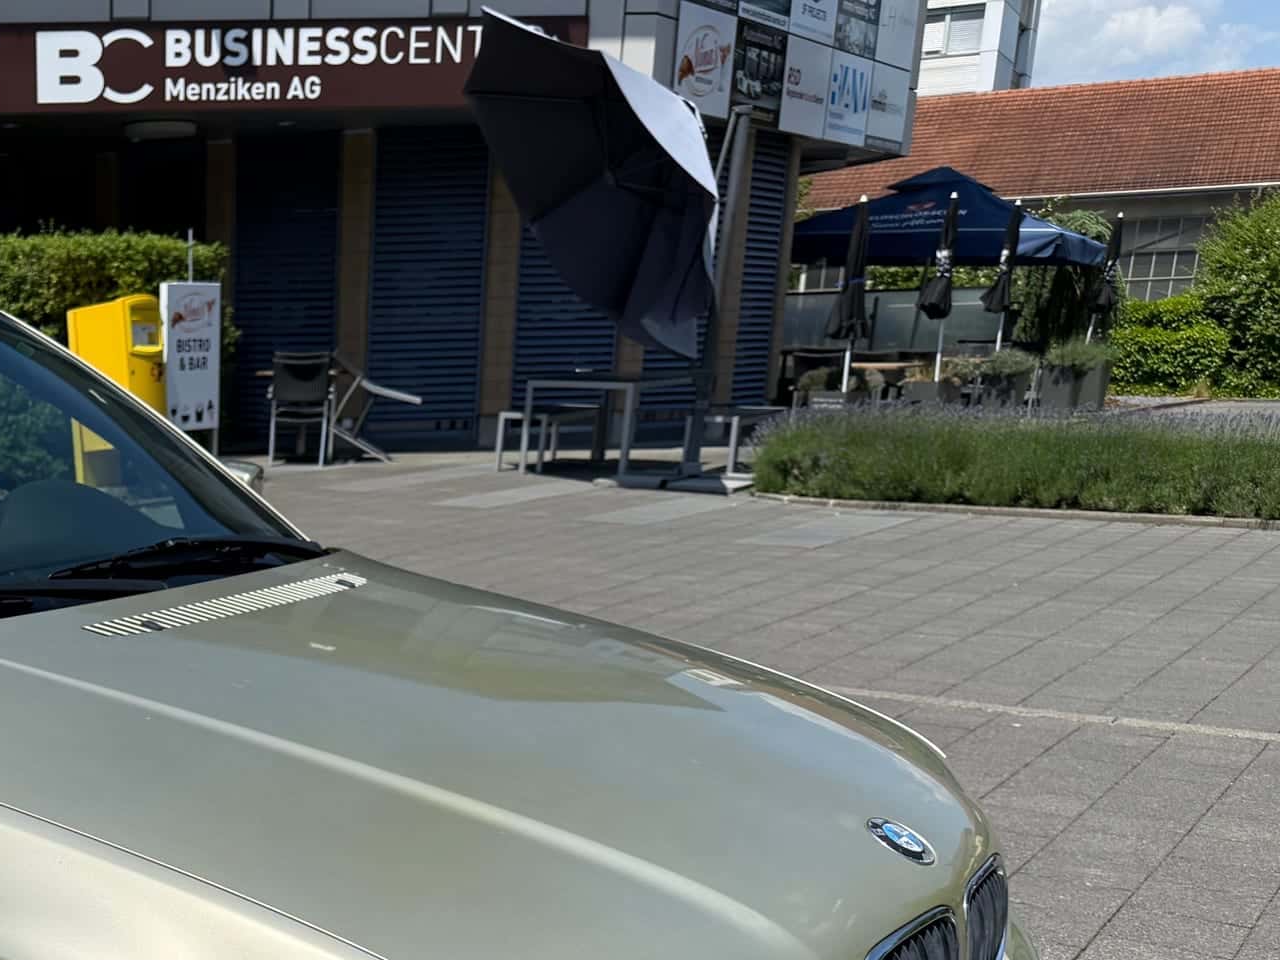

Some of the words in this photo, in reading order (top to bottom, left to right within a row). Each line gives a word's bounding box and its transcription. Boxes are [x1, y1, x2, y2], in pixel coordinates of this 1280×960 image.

[165, 25, 545, 67] BUSINESSCENT
[35, 28, 154, 104] BC
[165, 76, 280, 102] Menziken
[286, 76, 322, 100] AG
[176, 338, 212, 353] BISTRO
[188, 356, 209, 371] BAR
